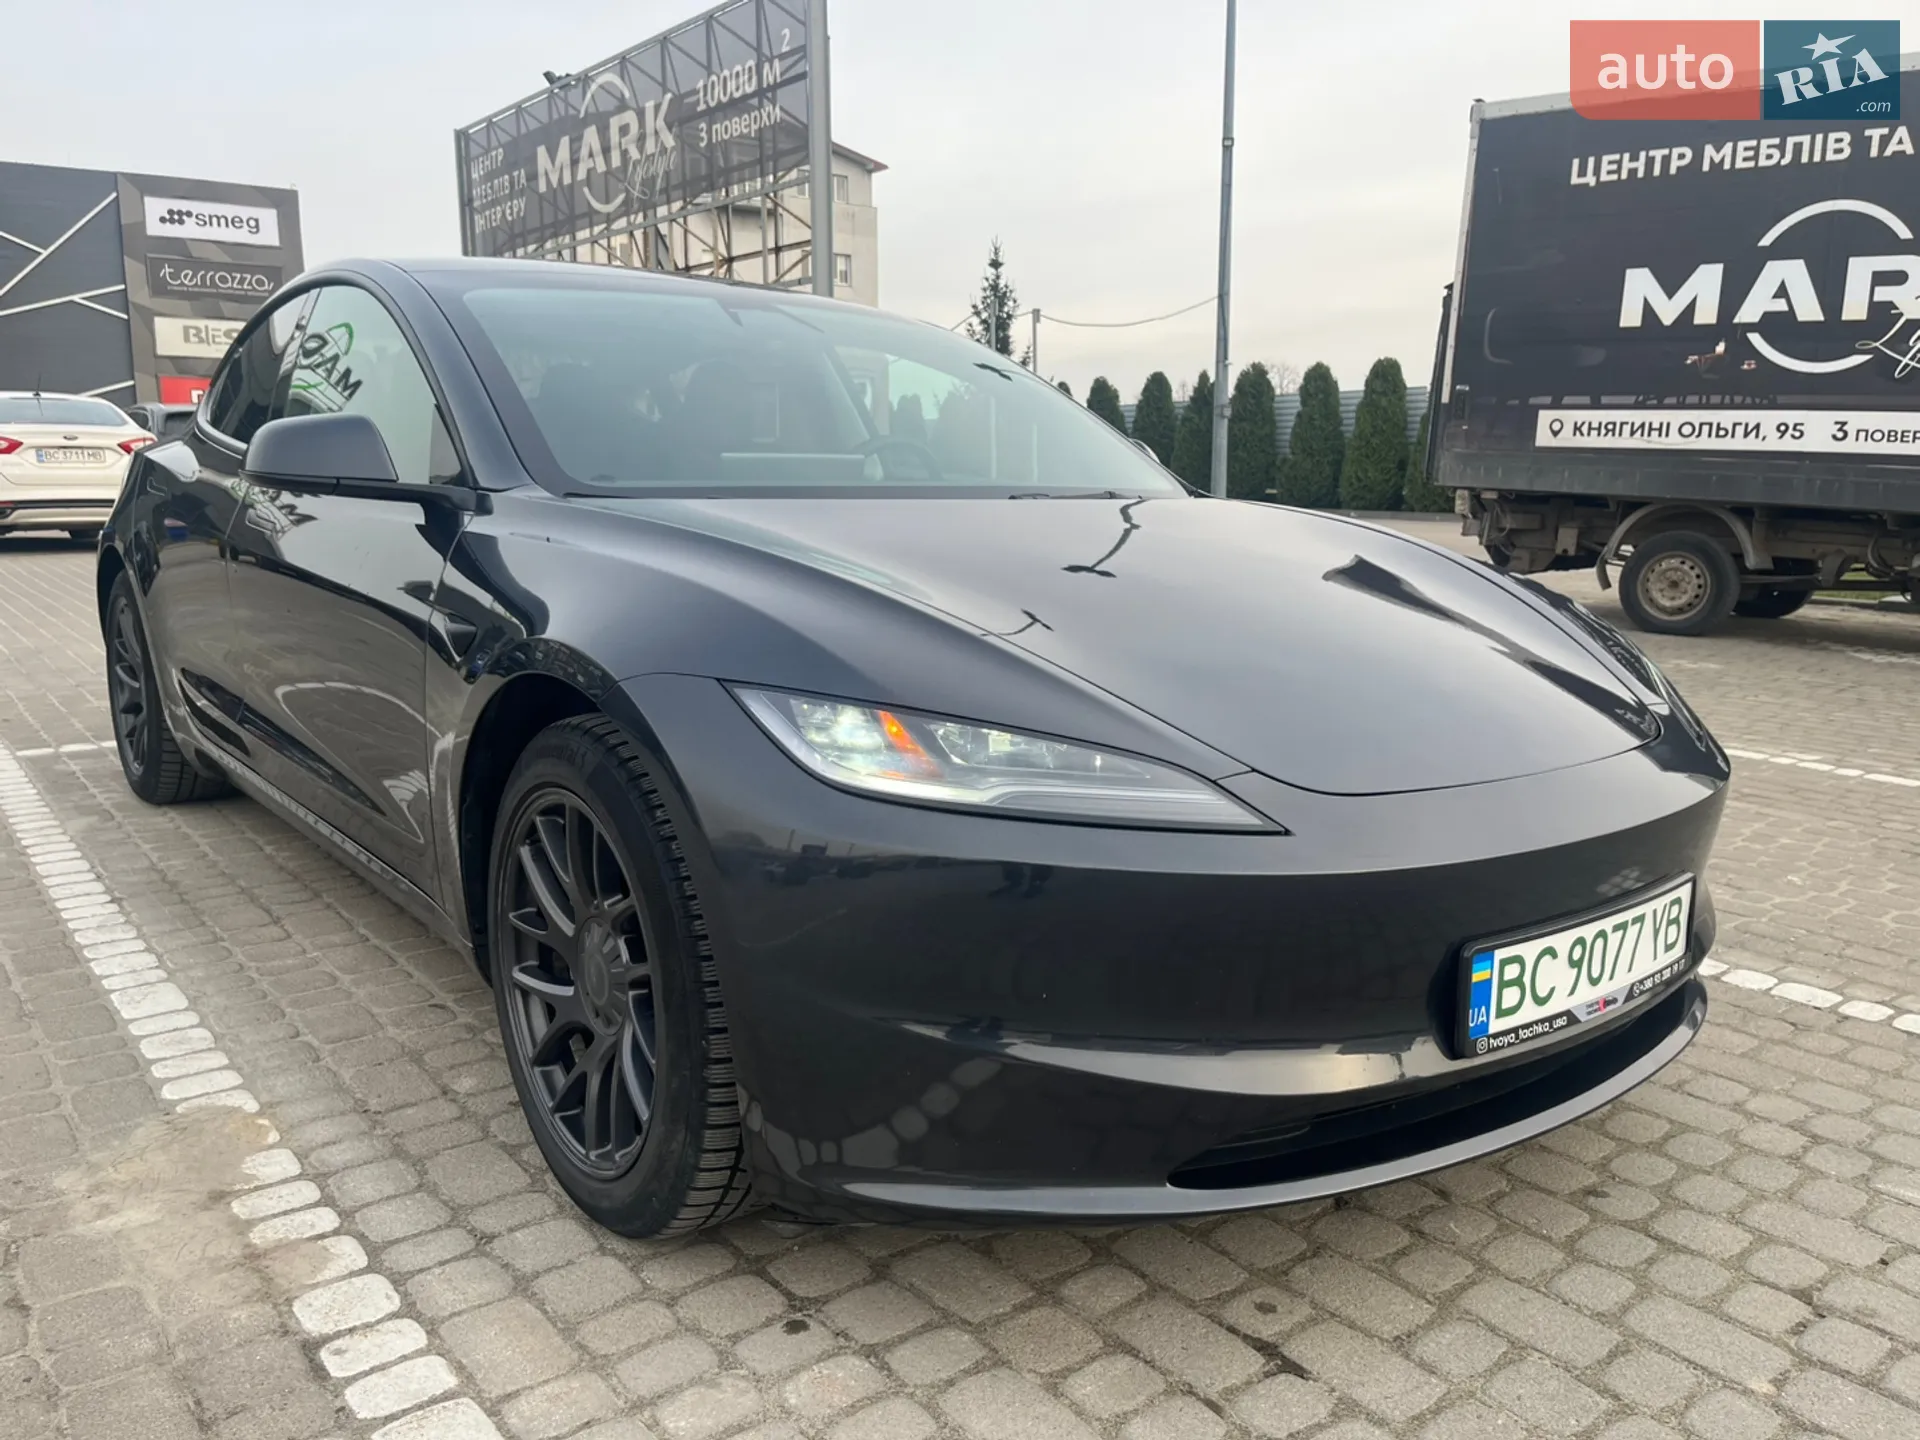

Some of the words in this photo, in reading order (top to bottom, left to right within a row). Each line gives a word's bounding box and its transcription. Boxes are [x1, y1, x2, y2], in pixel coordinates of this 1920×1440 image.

[696, 59, 757, 112] 10000
[536, 92, 676, 194] MARK
[698, 122, 708, 148] 3
[712, 103, 781, 144] поверхи
[471, 147, 504, 182] ЦЕНТР
[1570, 146, 1692, 187] ЦЕНТР
[1702, 131, 1852, 173] МЕБЛІВ
[1864, 125, 1915, 158] ТА
[512, 167, 527, 191] ТА
[194, 212, 260, 235] smeg
[160, 263, 274, 291] terrazza
[1571, 420, 1671, 438] КНЯГИНІ
[1677, 421, 1768, 442] ОЛЬГИ,
[1775, 422, 1805, 440] 95
[1831, 420, 1849, 442] 3
[1494, 945, 1558, 1020] BC
[1566, 912, 1647, 998] 9077
[1469, 1006, 1487, 1028] UA
